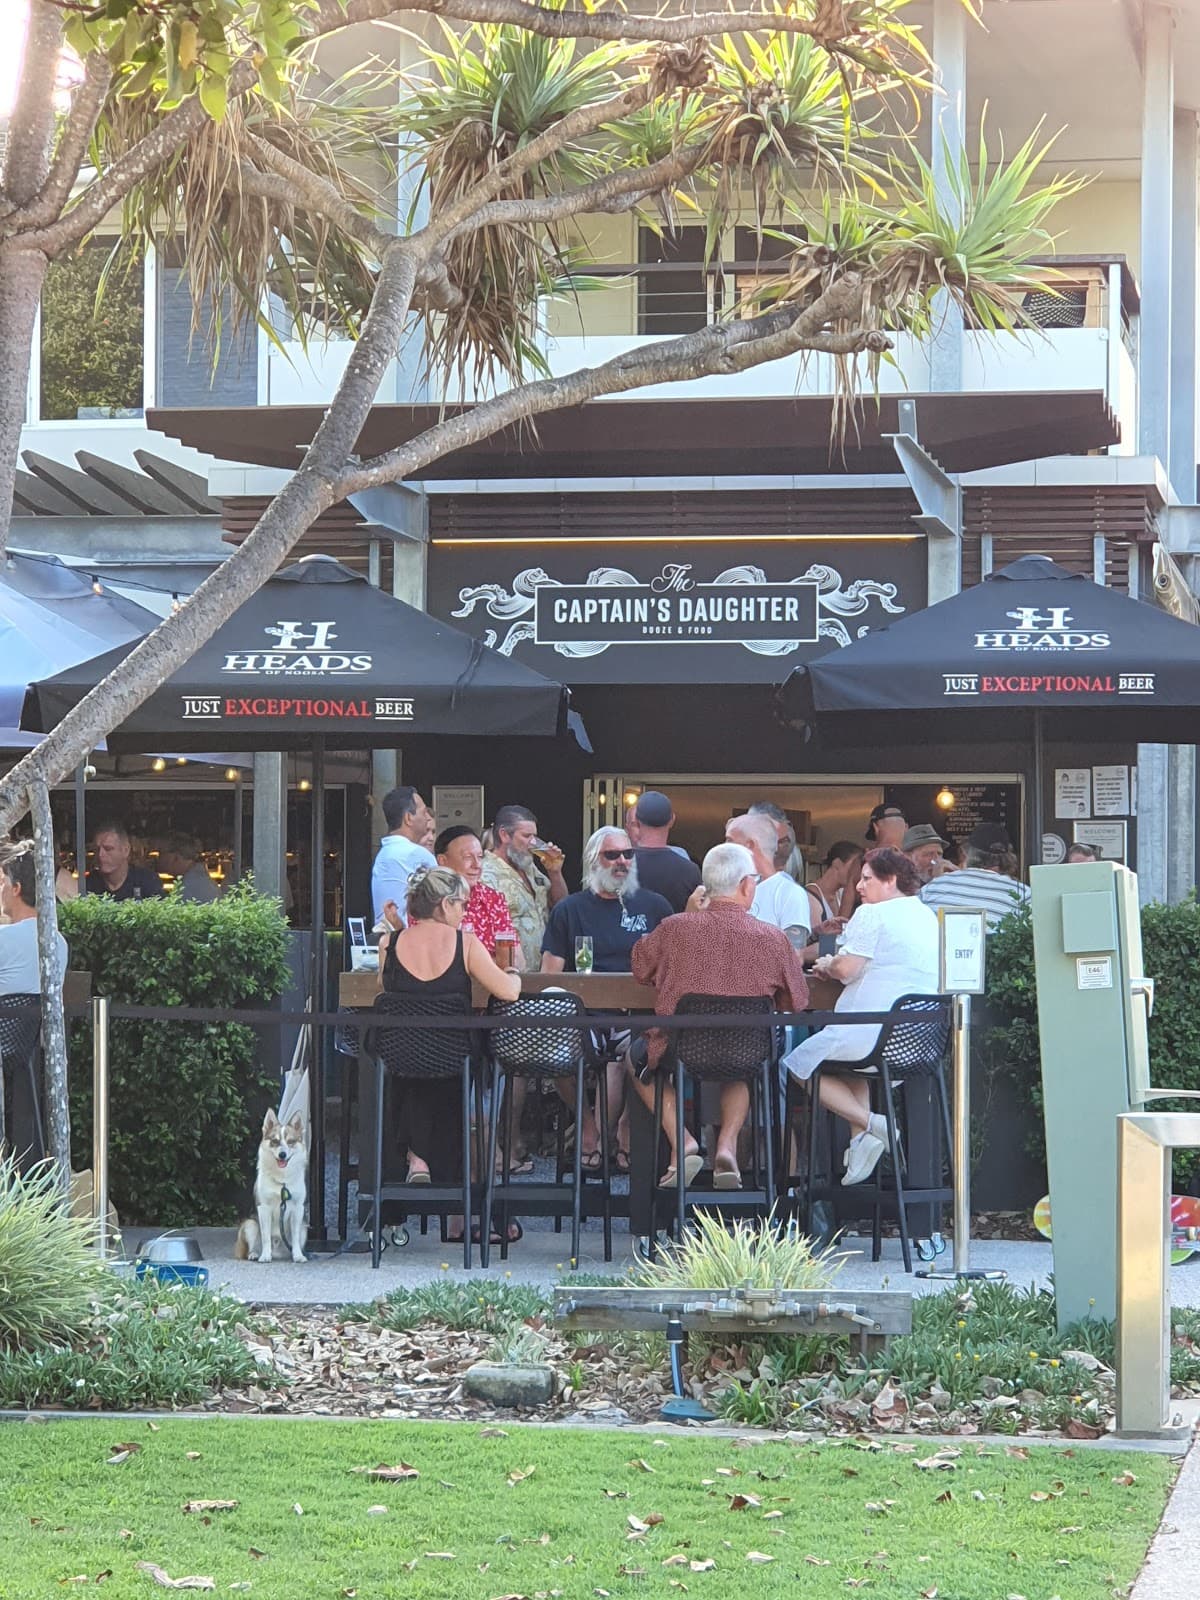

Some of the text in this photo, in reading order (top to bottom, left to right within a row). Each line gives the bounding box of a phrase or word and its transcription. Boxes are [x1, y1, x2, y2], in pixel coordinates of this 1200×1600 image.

[651, 563, 696, 593] The
[554, 597, 799, 623] CAPTAIN'S DAUGHTER
[642, 626, 672, 634] BOOZE
[688, 626, 712, 634] FOOD
[974, 633, 1111, 648] HEADS
[221, 655, 373, 671] HEADS
[945, 676, 1155, 693] JUST EXCEPTIONAL BEER
[184, 699, 414, 717] JUST EXCEPTIONAL BEER
[954, 949, 974, 959] ENTRY
